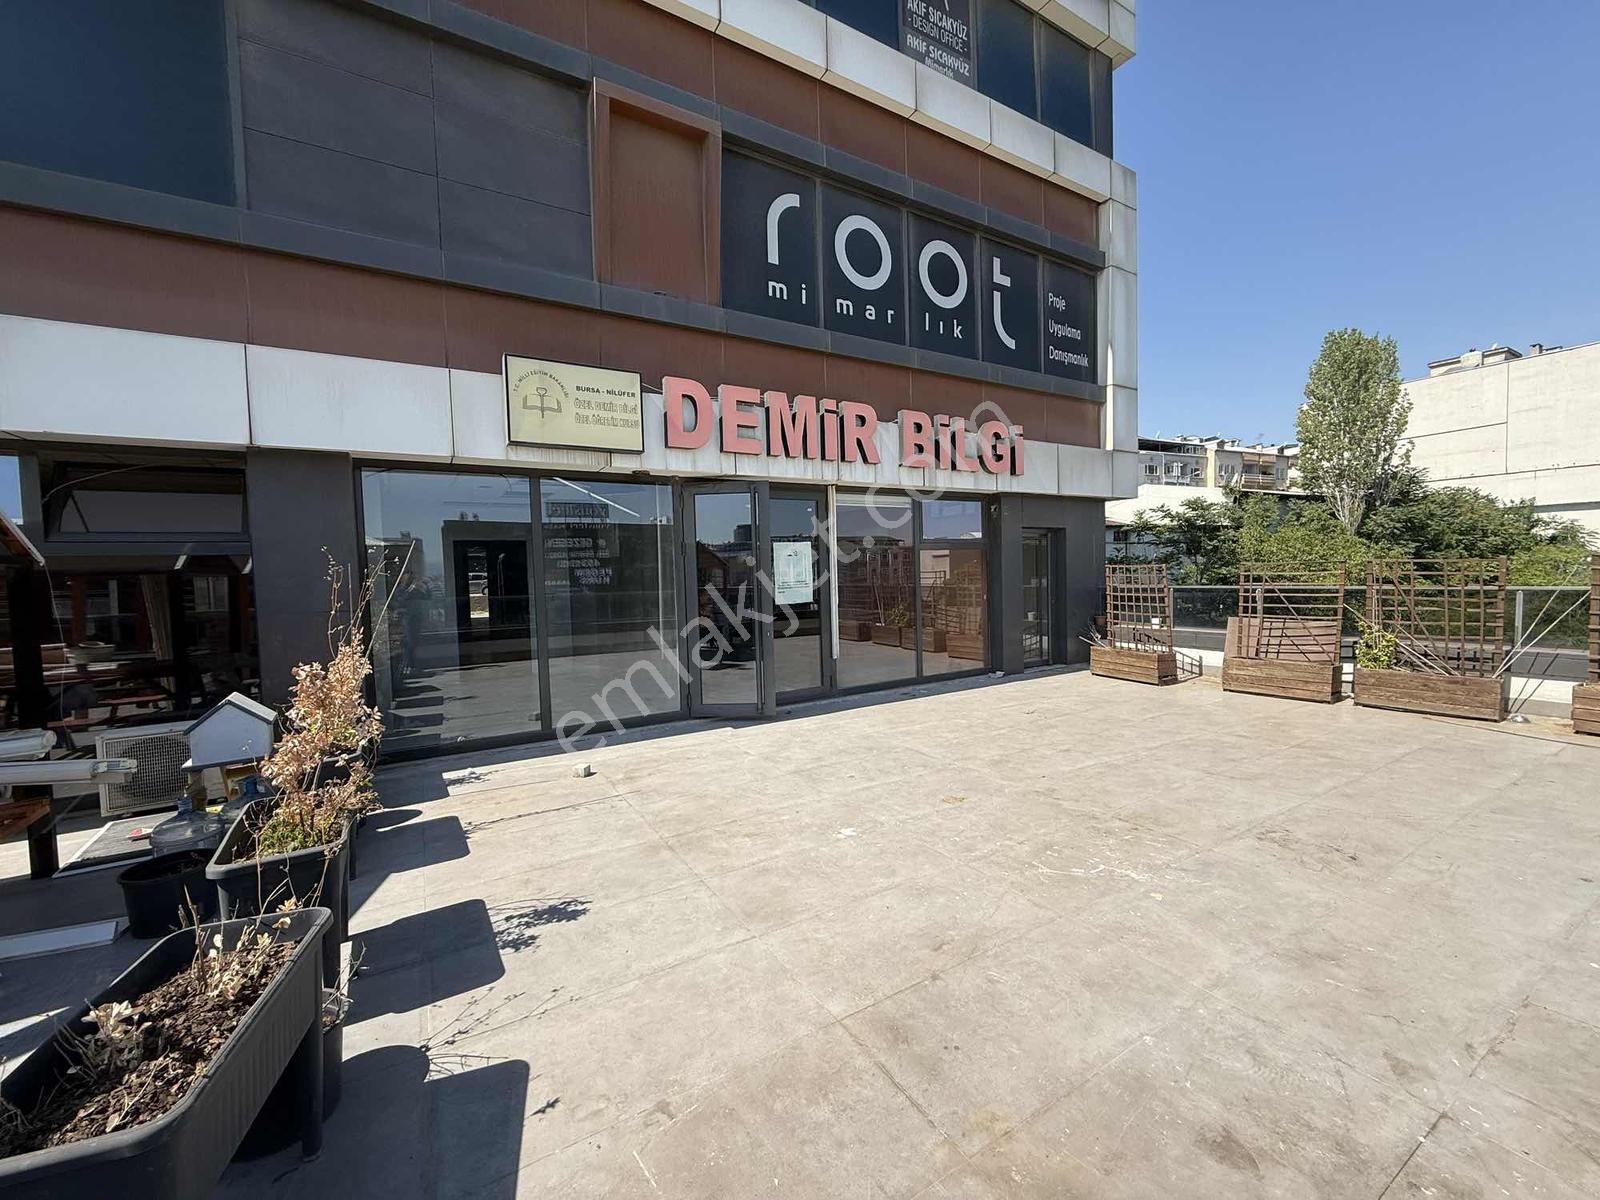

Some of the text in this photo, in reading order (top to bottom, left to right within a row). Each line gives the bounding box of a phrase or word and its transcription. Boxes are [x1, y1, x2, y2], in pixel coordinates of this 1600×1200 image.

[912, 14, 939, 39] DESIGN
[940, 29, 963, 52] OFFICE
[767, 193, 1016, 350] root
[1048, 291, 1066, 312] Proje
[1048, 319, 1081, 341] Uygulama
[1048, 345, 1089, 367] Danışmanlık
[575, 385, 601, 394] BURSA
[606, 388, 636, 398] NİLÜFER
